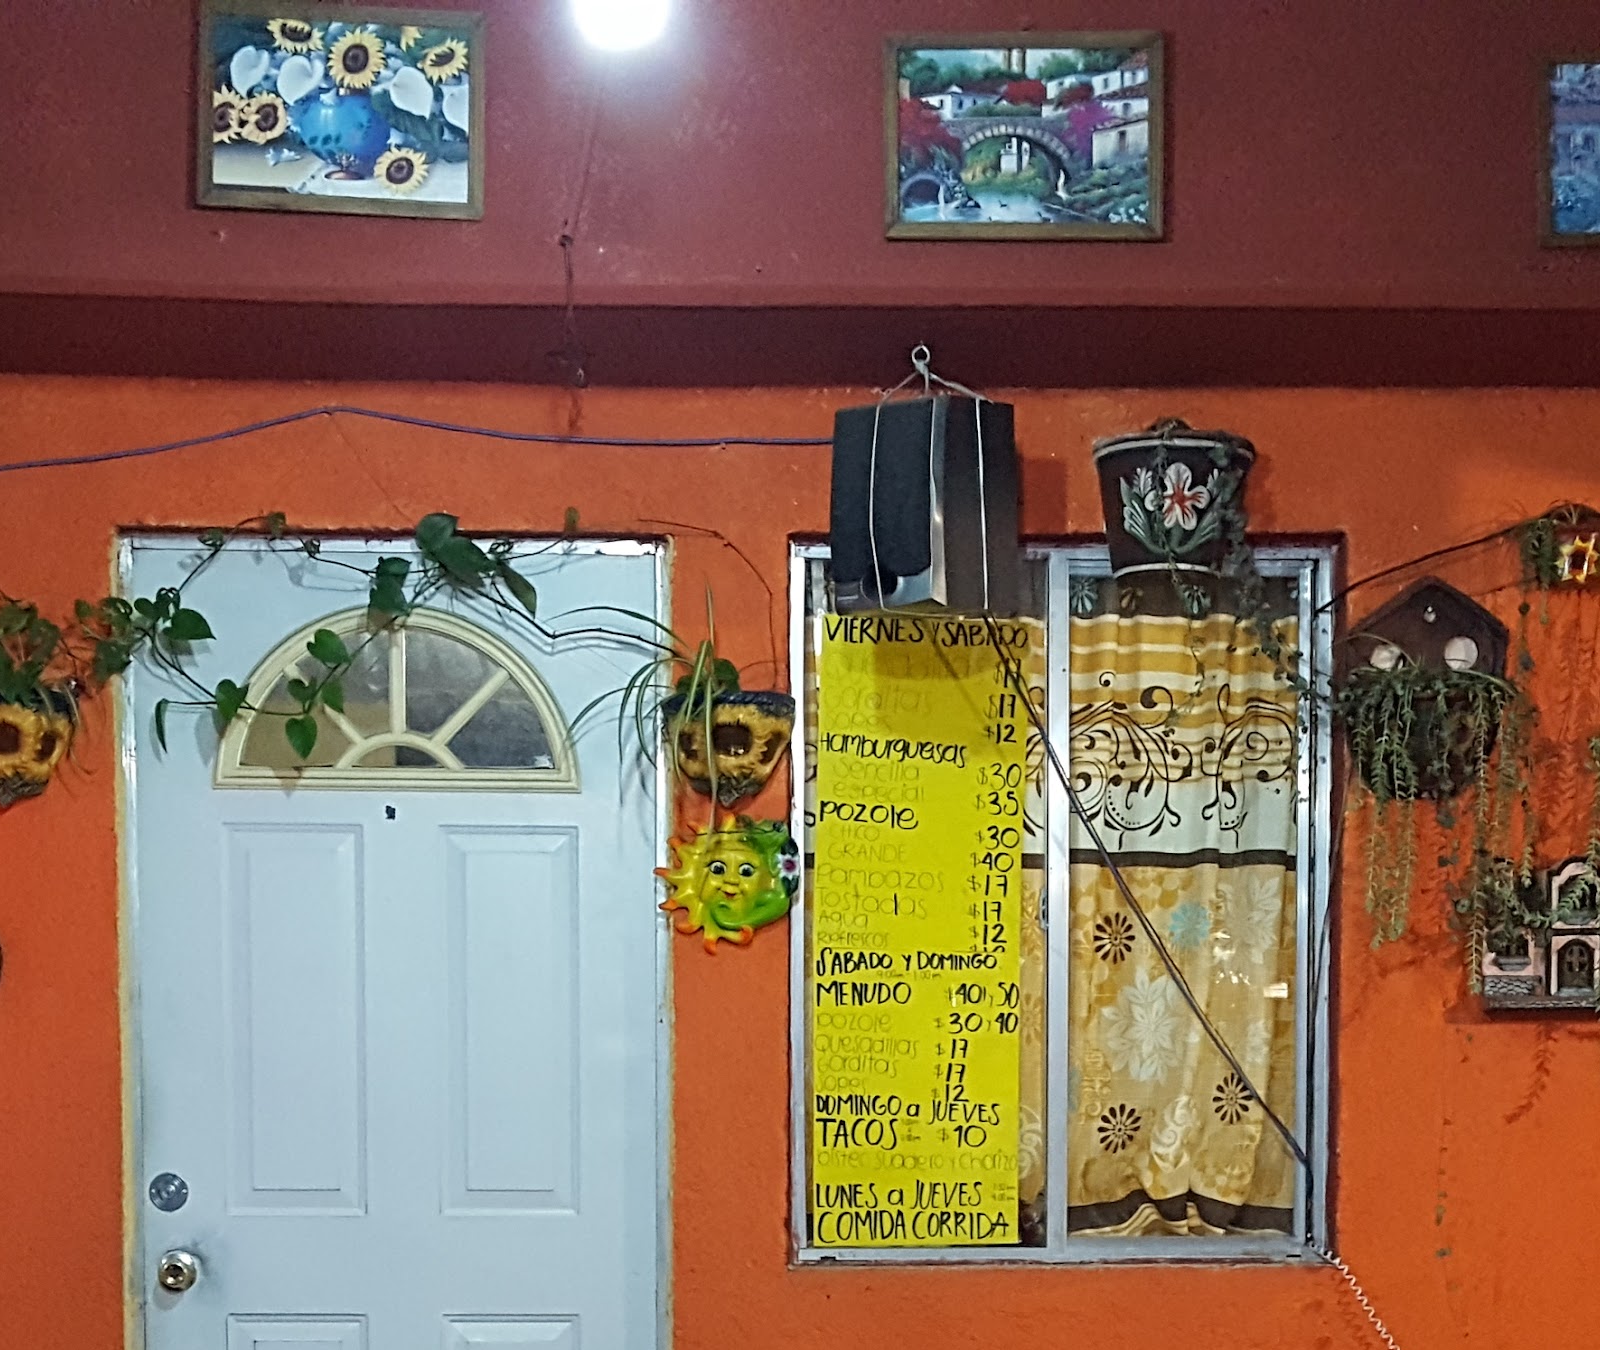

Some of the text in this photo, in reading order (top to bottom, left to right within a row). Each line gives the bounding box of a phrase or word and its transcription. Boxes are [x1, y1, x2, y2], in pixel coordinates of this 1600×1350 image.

[824, 616, 925, 645] VIERNES
[983, 692, 1017, 719] $17
[983, 722, 1017, 745] $12
[819, 731, 968, 769] Hamburguesas
[976, 762, 1023, 791] $30
[974, 790, 1020, 817] $35
[974, 825, 1021, 850] $30
[969, 851, 1015, 873] $40
[966, 873, 1009, 898] $17
[967, 900, 1002, 922] $17
[967, 923, 1008, 946] $12
[816, 946, 894, 977] SABADO
[916, 950, 998, 971] DOMINGO
[816, 980, 912, 1008] MENUDO
[995, 1011, 1020, 1035] 40
[816, 1093, 1002, 1127] DOMINGO a JUEVES
[815, 1117, 900, 1150] TACOS
[815, 1182, 879, 1210] LUNES
[887, 1188, 904, 1206] a
[909, 1179, 983, 1210] JUEVES
[817, 1209, 1010, 1244] COMIDA CORRIDA
